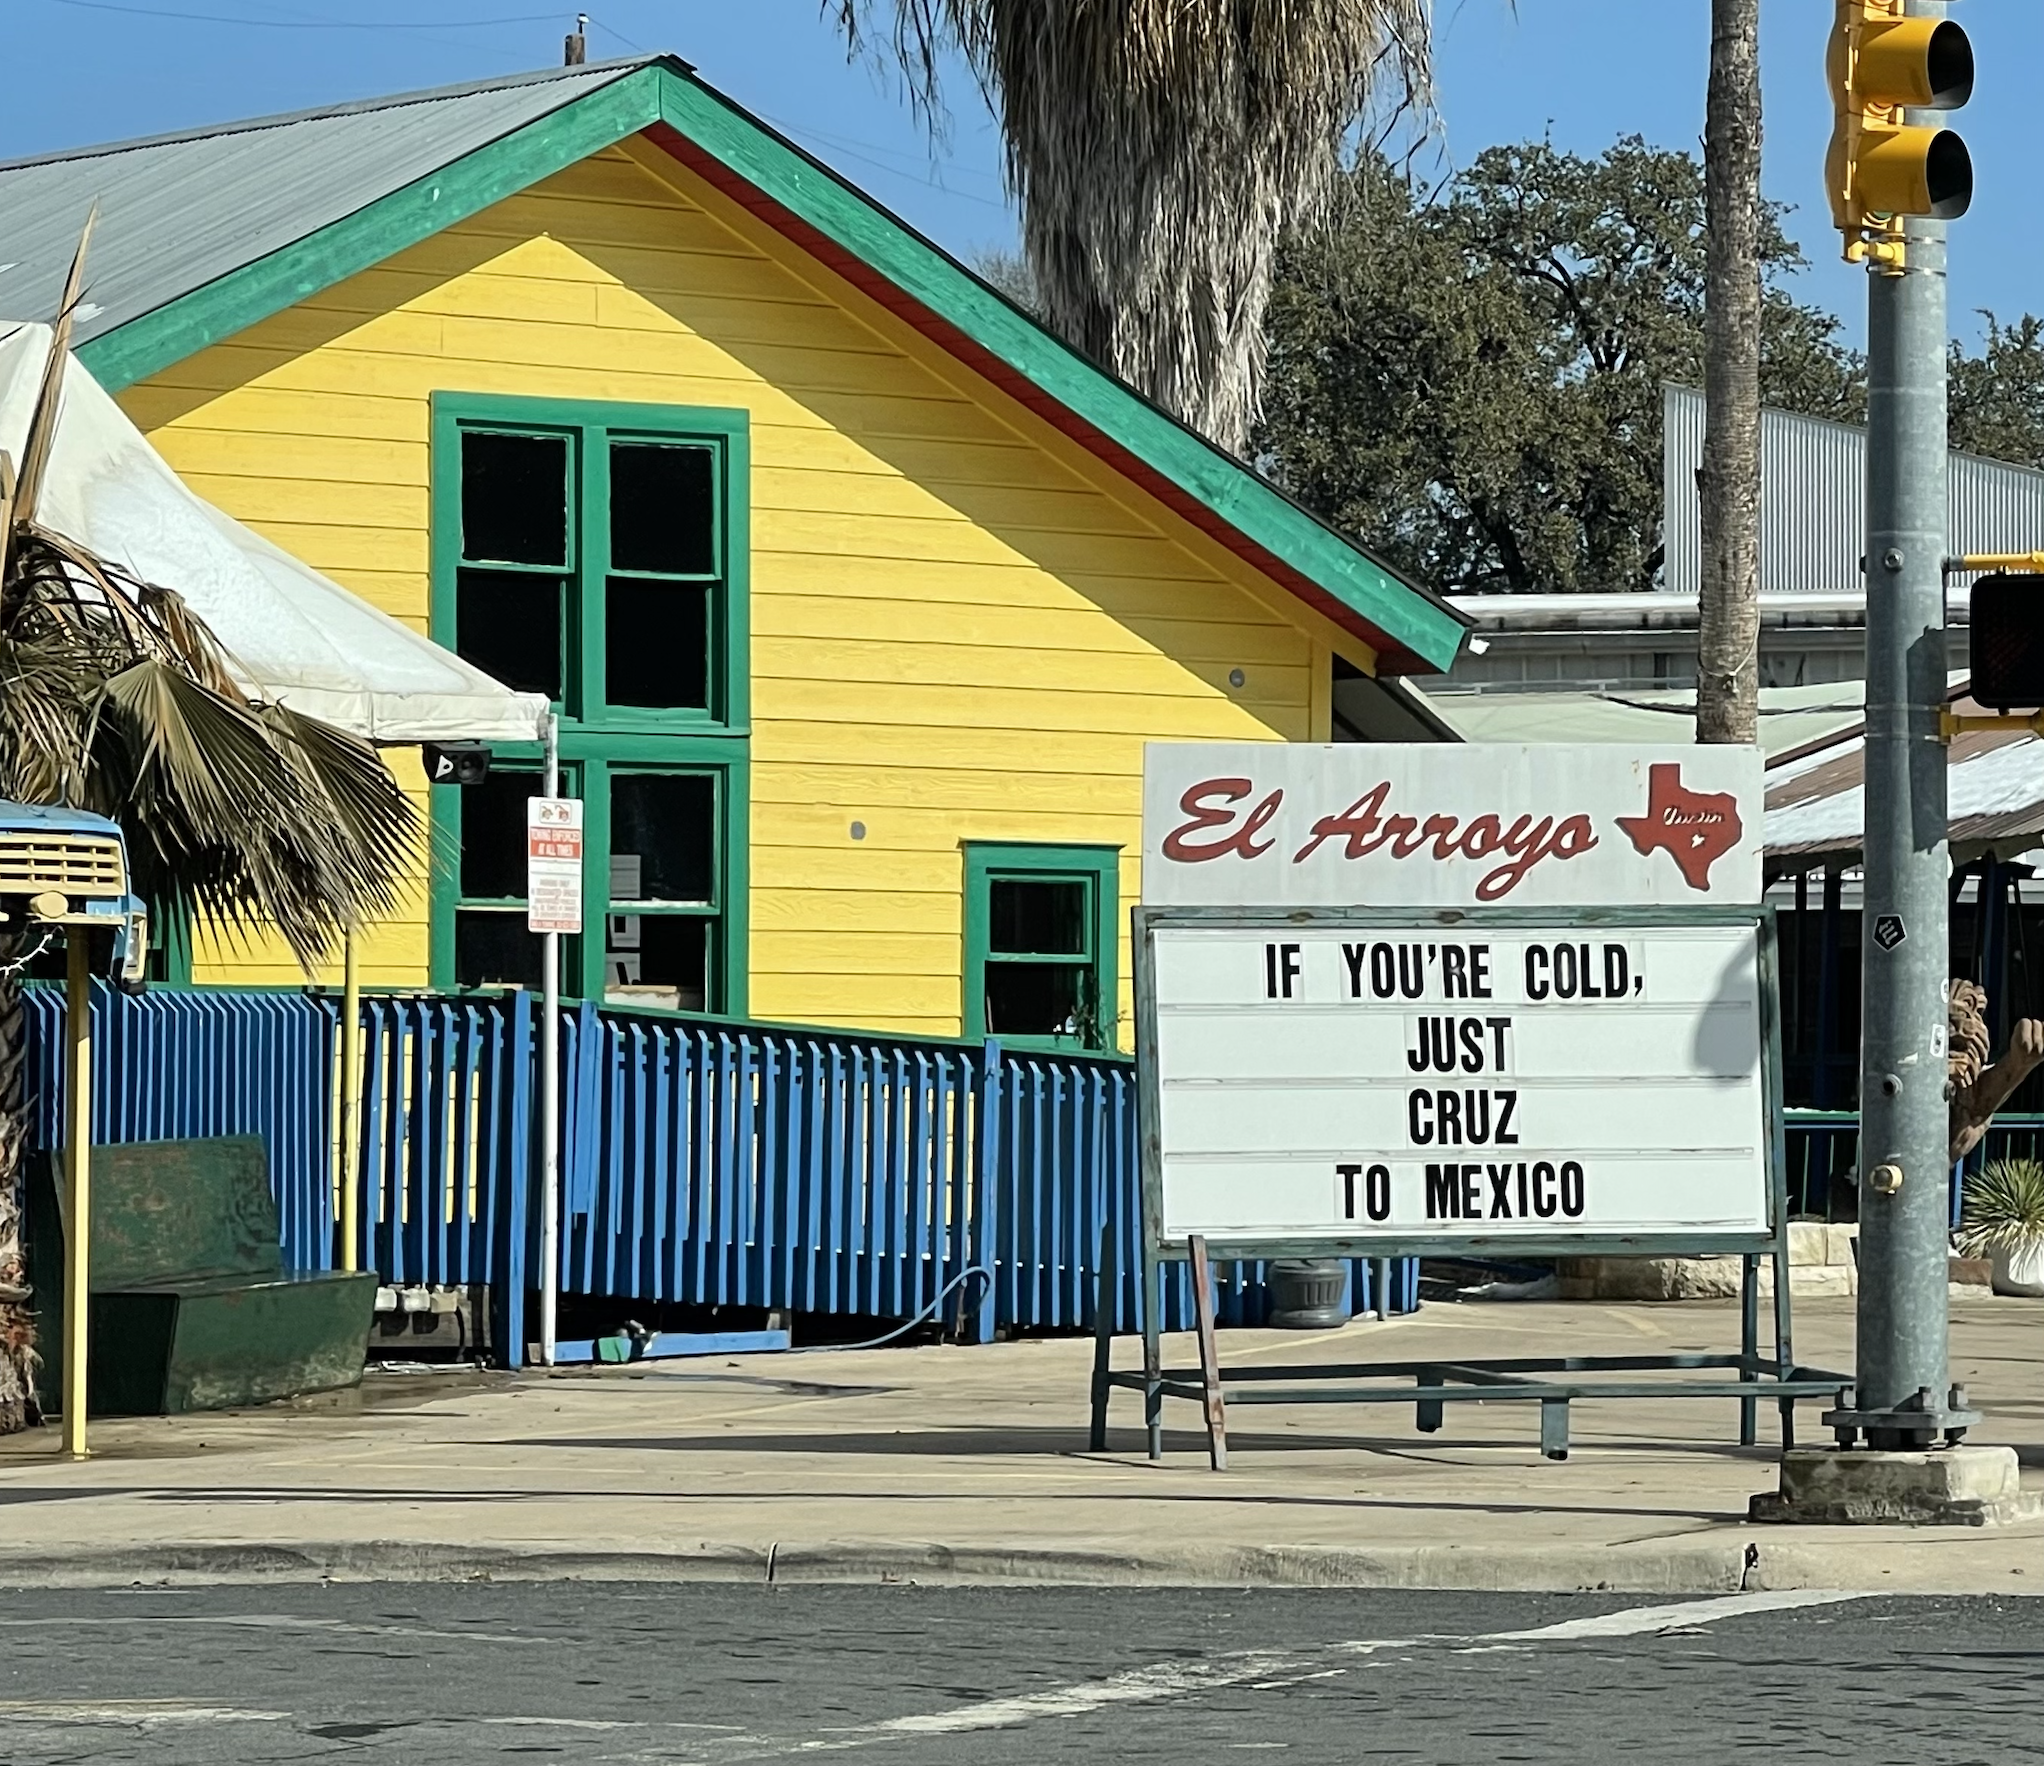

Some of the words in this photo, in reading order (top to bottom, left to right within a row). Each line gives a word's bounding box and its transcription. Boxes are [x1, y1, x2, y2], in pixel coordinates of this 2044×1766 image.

[1162, 778, 1284, 862] El
[1293, 781, 1599, 901] Arroyo
[1266, 944, 1301, 998] IF
[1341, 942, 1492, 998] YOU'RE
[1525, 943, 1644, 1000] COLD,
[1407, 1016, 1512, 1073] JUST
[1408, 1088, 1519, 1145] CRUZ
[1336, 1164, 1390, 1221] TO
[1425, 1161, 1584, 1219] MEXICO
